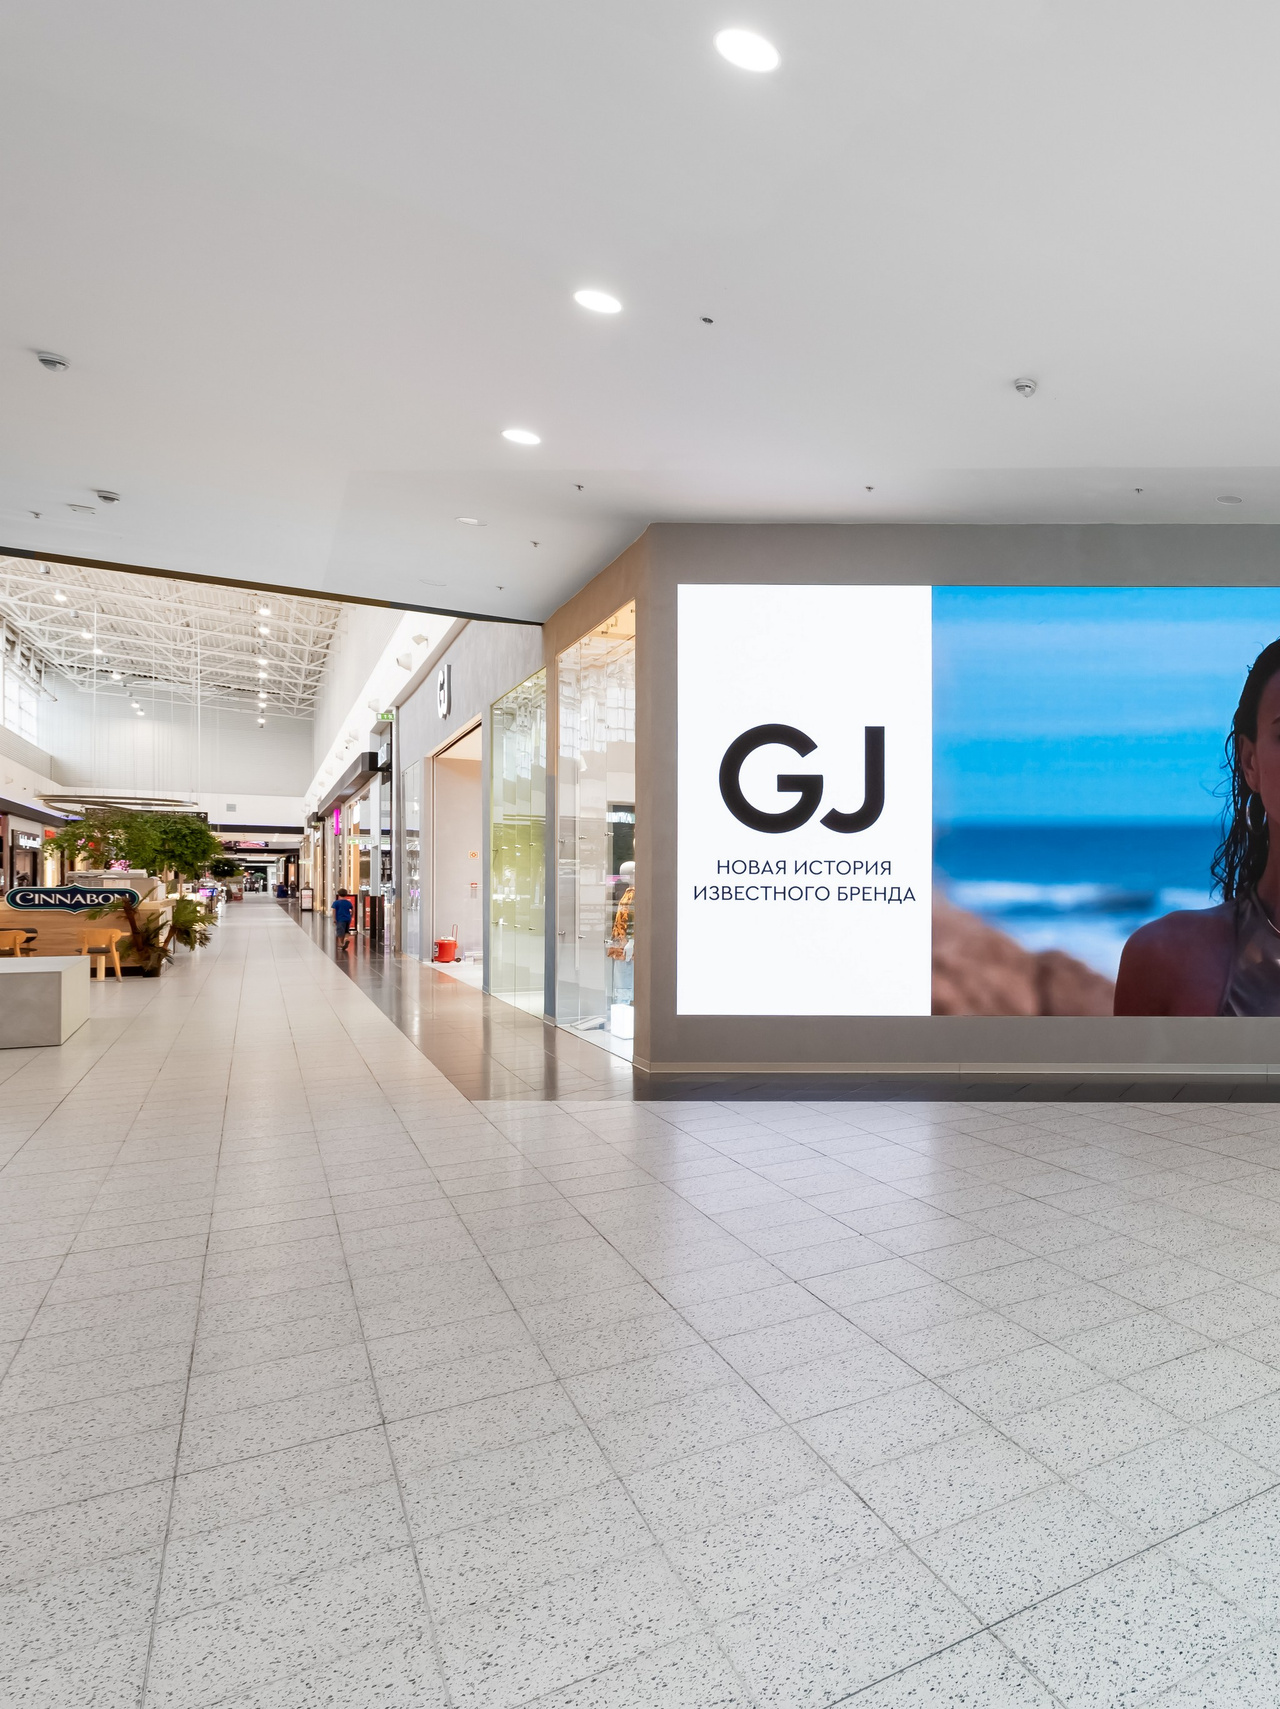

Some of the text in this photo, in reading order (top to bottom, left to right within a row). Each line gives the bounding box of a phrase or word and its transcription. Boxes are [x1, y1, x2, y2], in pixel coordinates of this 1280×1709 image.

[719, 723, 885, 834] GJ
[717, 859, 892, 876] НОВАЯ ИСТОРИЯ
[693, 885, 917, 904] ИЗВЕСТНОГО БРЕНДА
